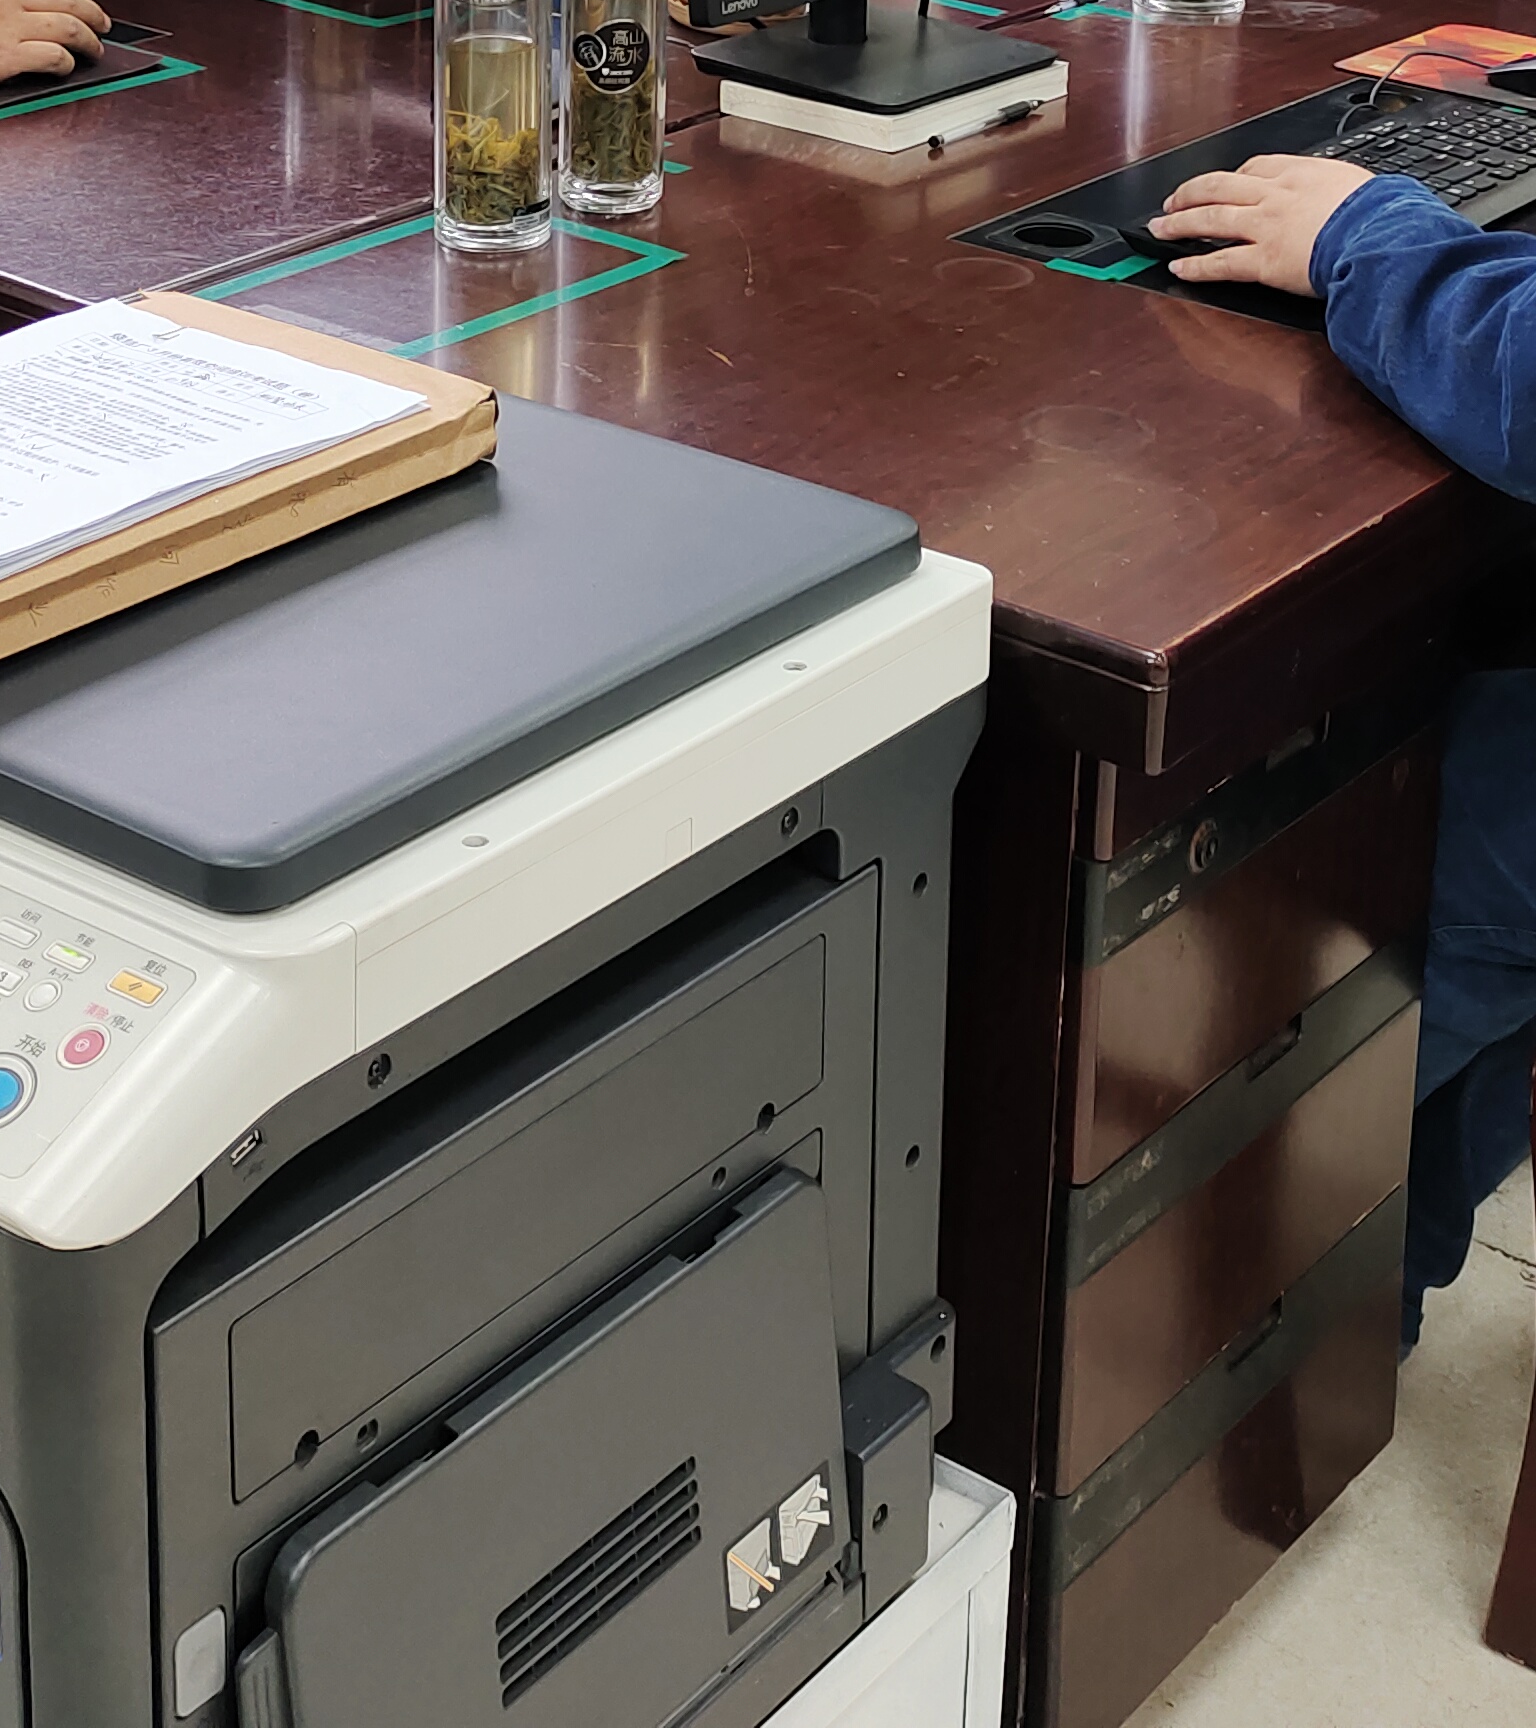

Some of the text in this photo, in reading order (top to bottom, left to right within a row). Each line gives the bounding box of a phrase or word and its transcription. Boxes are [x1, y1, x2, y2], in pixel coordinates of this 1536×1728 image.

[611, 28, 644, 47] 高山
[607, 46, 644, 68] 流水
[20, 907, 43, 924] 访问
[74, 932, 97, 949] 节能
[141, 958, 168, 978] 复位
[14, 1032, 49, 1059] 开始
